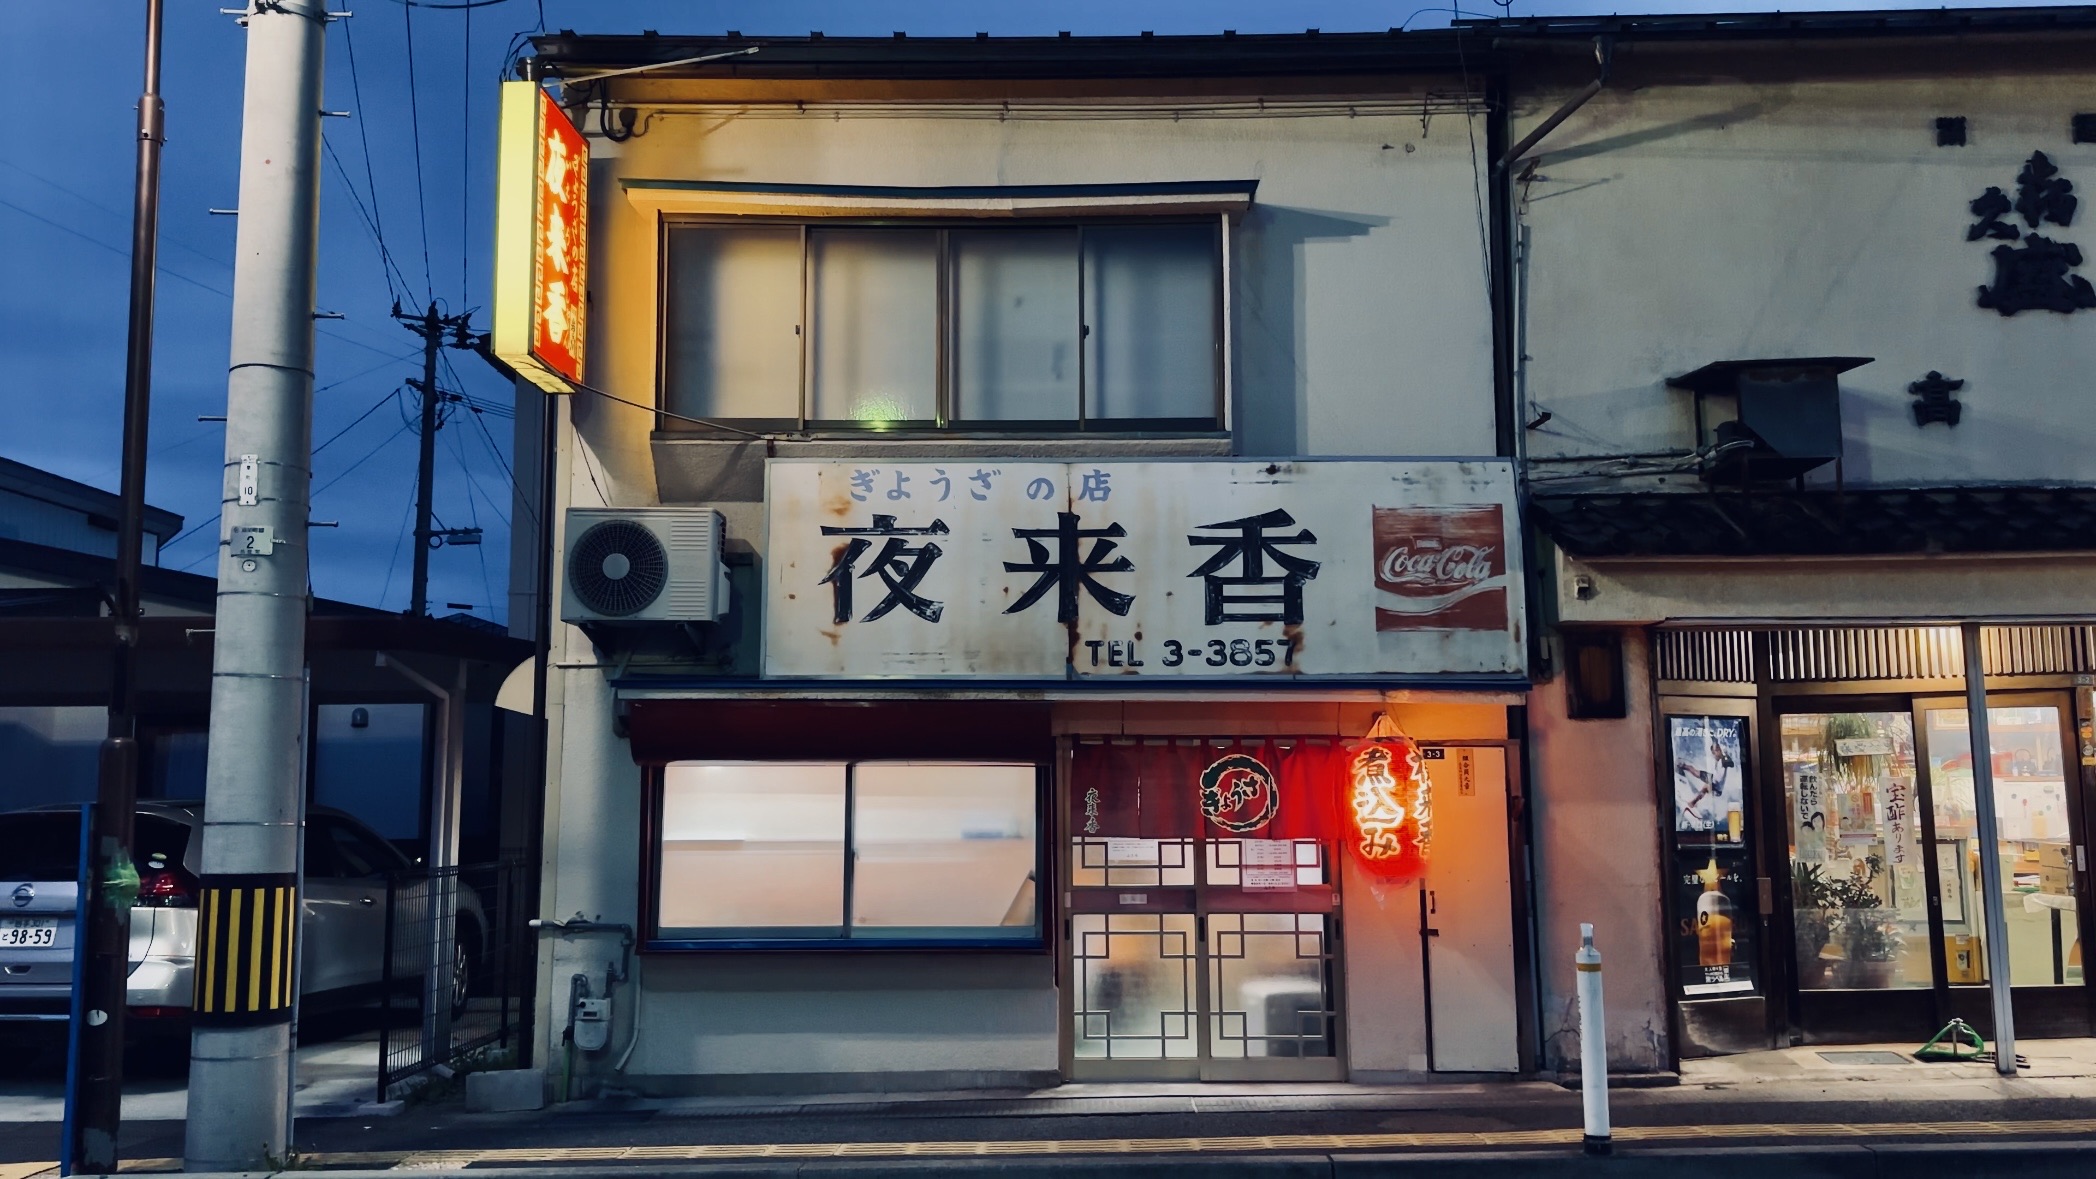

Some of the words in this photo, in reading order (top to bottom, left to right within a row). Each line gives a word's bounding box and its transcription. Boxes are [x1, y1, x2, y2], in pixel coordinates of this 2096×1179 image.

[246, 536, 254, 549] 2
[818, 507, 1322, 625] 夜来香
[1379, 545, 1495, 583] Coca-Cola
[1085, 640, 1144, 667] TEL
[1162, 639, 1294, 667] 3-3857
[1426, 750, 1441, 758] 3-3
[1352, 746, 1404, 859] 煮込み
[1886, 782, 1907, 864] 宝酢あります
[10, 929, 52, 944] 98-59
